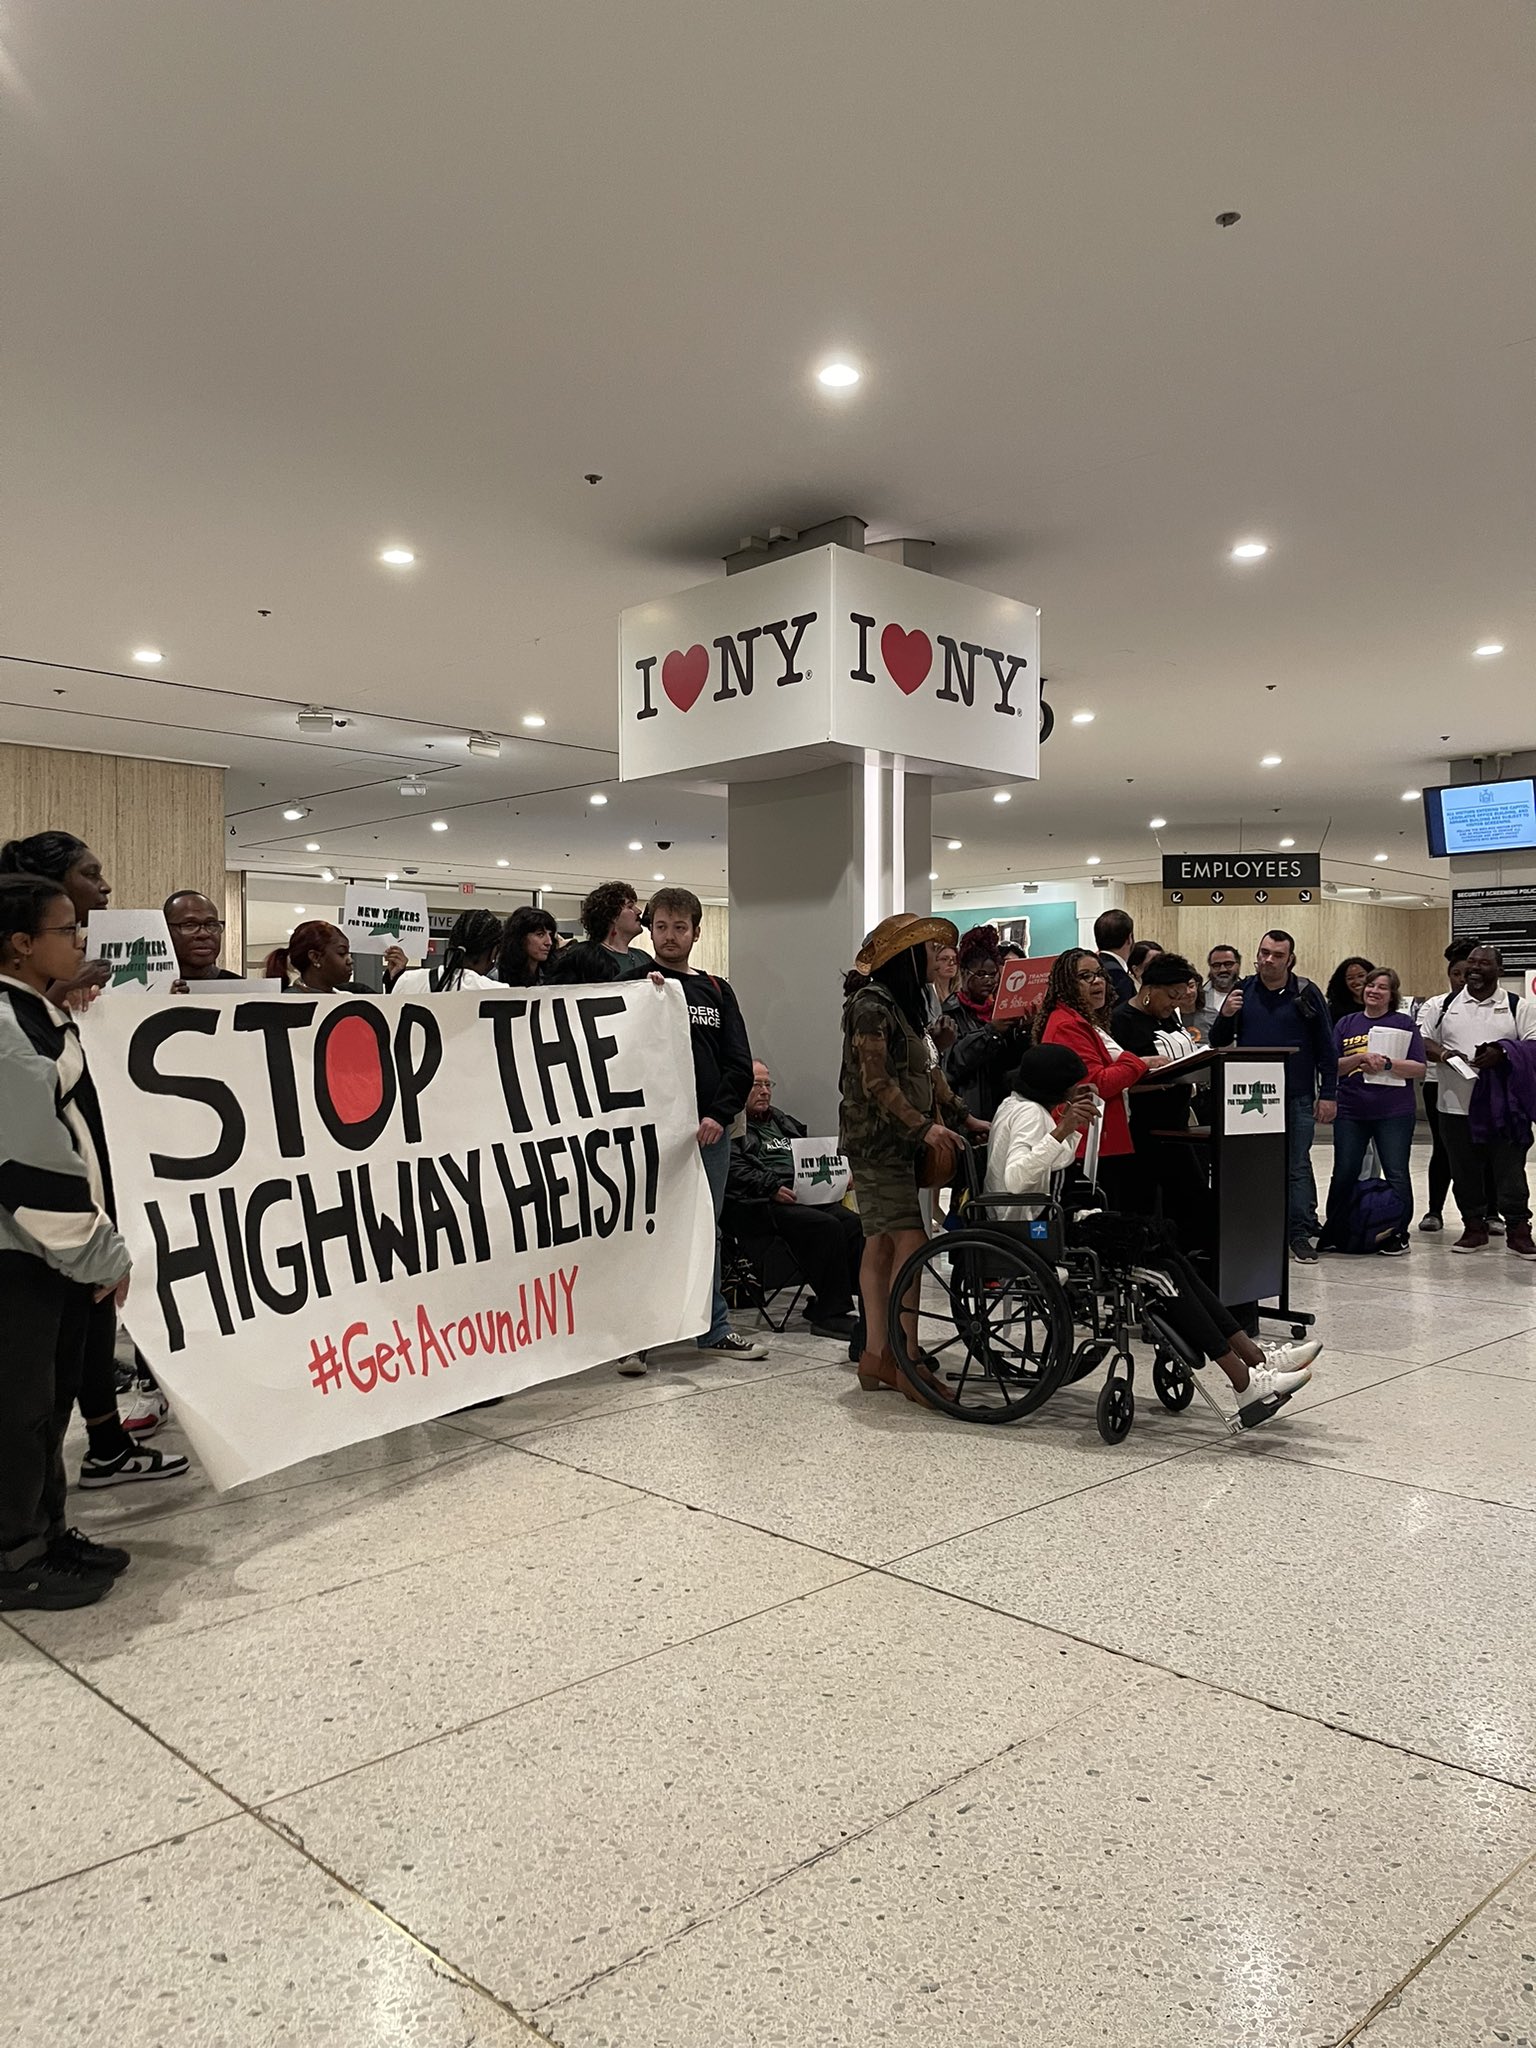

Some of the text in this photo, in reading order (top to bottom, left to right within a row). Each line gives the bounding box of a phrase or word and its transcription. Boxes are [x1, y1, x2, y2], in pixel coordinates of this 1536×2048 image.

[850, 612, 876, 684] I
[636, 655, 658, 720] I
[1181, 860, 1302, 878] EMPLOYEES
[357, 906, 420, 923] NEW YORKERS
[100, 940, 167, 959] NEW YORKERS
[156, 961, 174, 972] EQUITY
[691, 1014, 721, 1029] ANCE
[128, 996, 646, 1180] STOP THE
[1232, 1084, 1247, 1095] NEW
[801, 1158, 814, 1168] NEW
[144, 1124, 660, 1353] HIGHWAY HEIST!
[309, 1266, 579, 1395] #GetAroundNY
